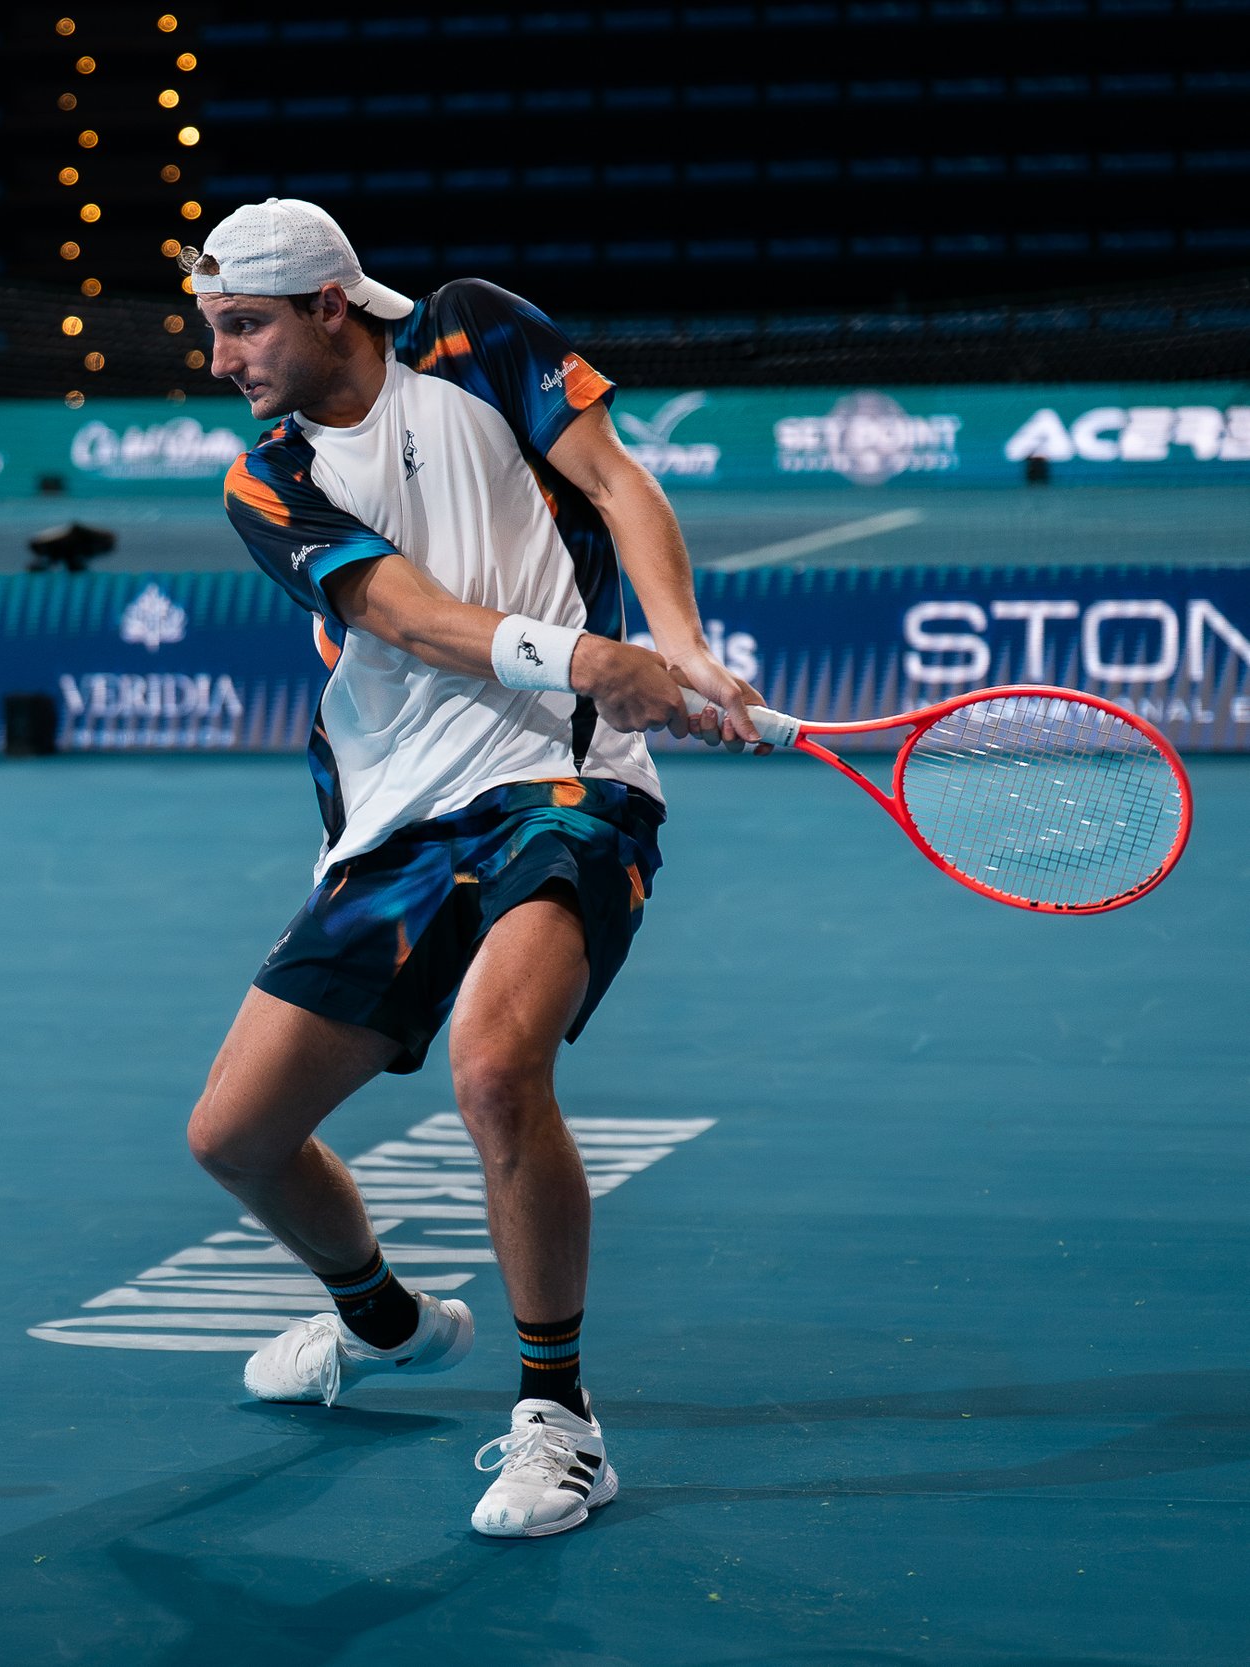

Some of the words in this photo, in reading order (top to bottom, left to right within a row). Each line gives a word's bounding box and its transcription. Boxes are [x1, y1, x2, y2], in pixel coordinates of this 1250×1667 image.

[540, 359, 579, 392] Australian
[290, 543, 330, 571] Austran
[59, 672, 243, 718] VERIDIA
